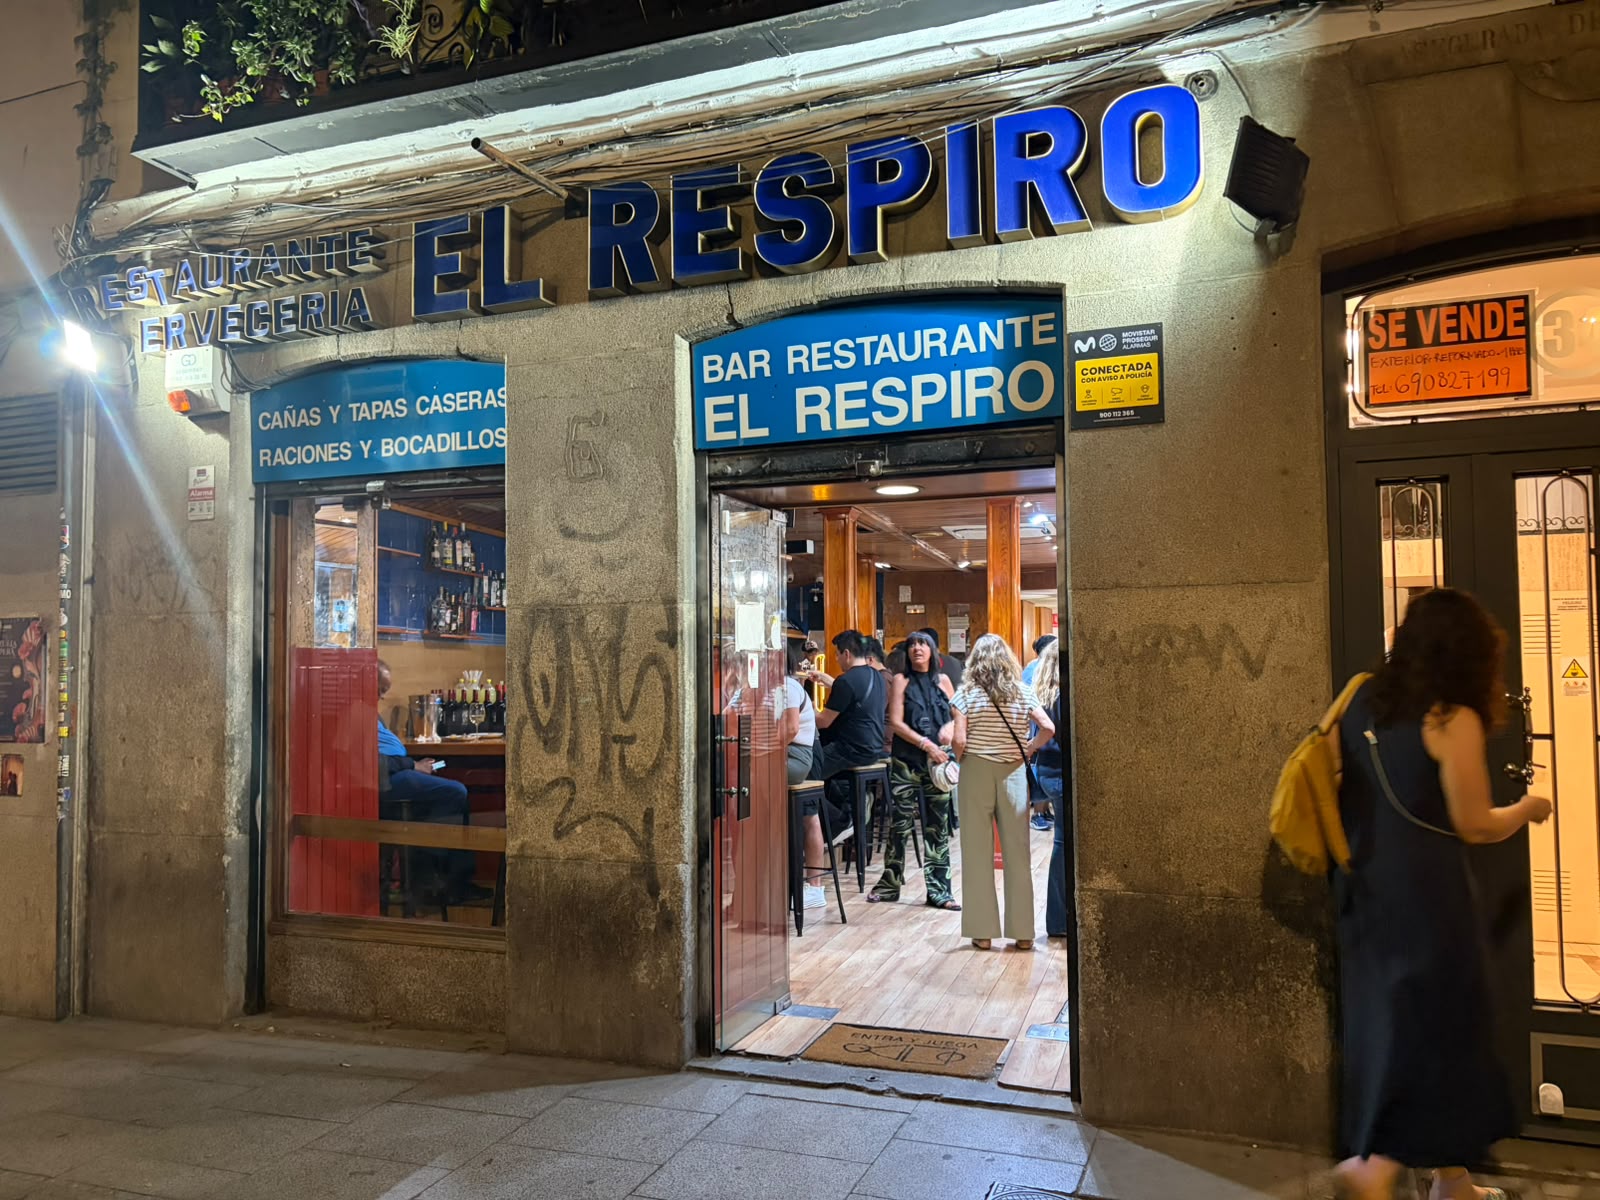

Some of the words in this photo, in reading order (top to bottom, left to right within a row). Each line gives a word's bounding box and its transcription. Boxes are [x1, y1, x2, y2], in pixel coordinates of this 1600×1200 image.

[412, 204, 545, 322] EL
[588, 84, 1204, 291] RESPIRO
[68, 227, 374, 324] RESTAURANTE
[1122, 329, 1156, 338] MOVISTAR
[1367, 311, 1408, 350] SE
[1415, 299, 1527, 345] VENDE
[702, 349, 771, 384] BAR
[787, 312, 1057, 375] RESTAURANTE
[1122, 335, 1159, 344] PROSEGUR
[1122, 342, 1152, 350] ALARMAS
[1081, 361, 1153, 376] CONECTADA
[1097, 374, 1118, 382] AVISO
[1126, 370, 1153, 379] POLICÍA
[258, 405, 322, 431] CAÑAS
[328, 405, 341, 424] Y
[348, 398, 408, 422] TAPAS
[415, 387, 506, 416] CASERAS
[704, 393, 770, 442] EL
[795, 359, 1056, 434] RESPIRO
[259, 441, 352, 467] RACIONES
[359, 440, 373, 459] Y
[381, 427, 507, 458] BOCADILLOS
[190, 488, 214, 498] Alarma
[850, 1032, 904, 1042] ENTRA
[926, 1039, 979, 1049] JUEGA
